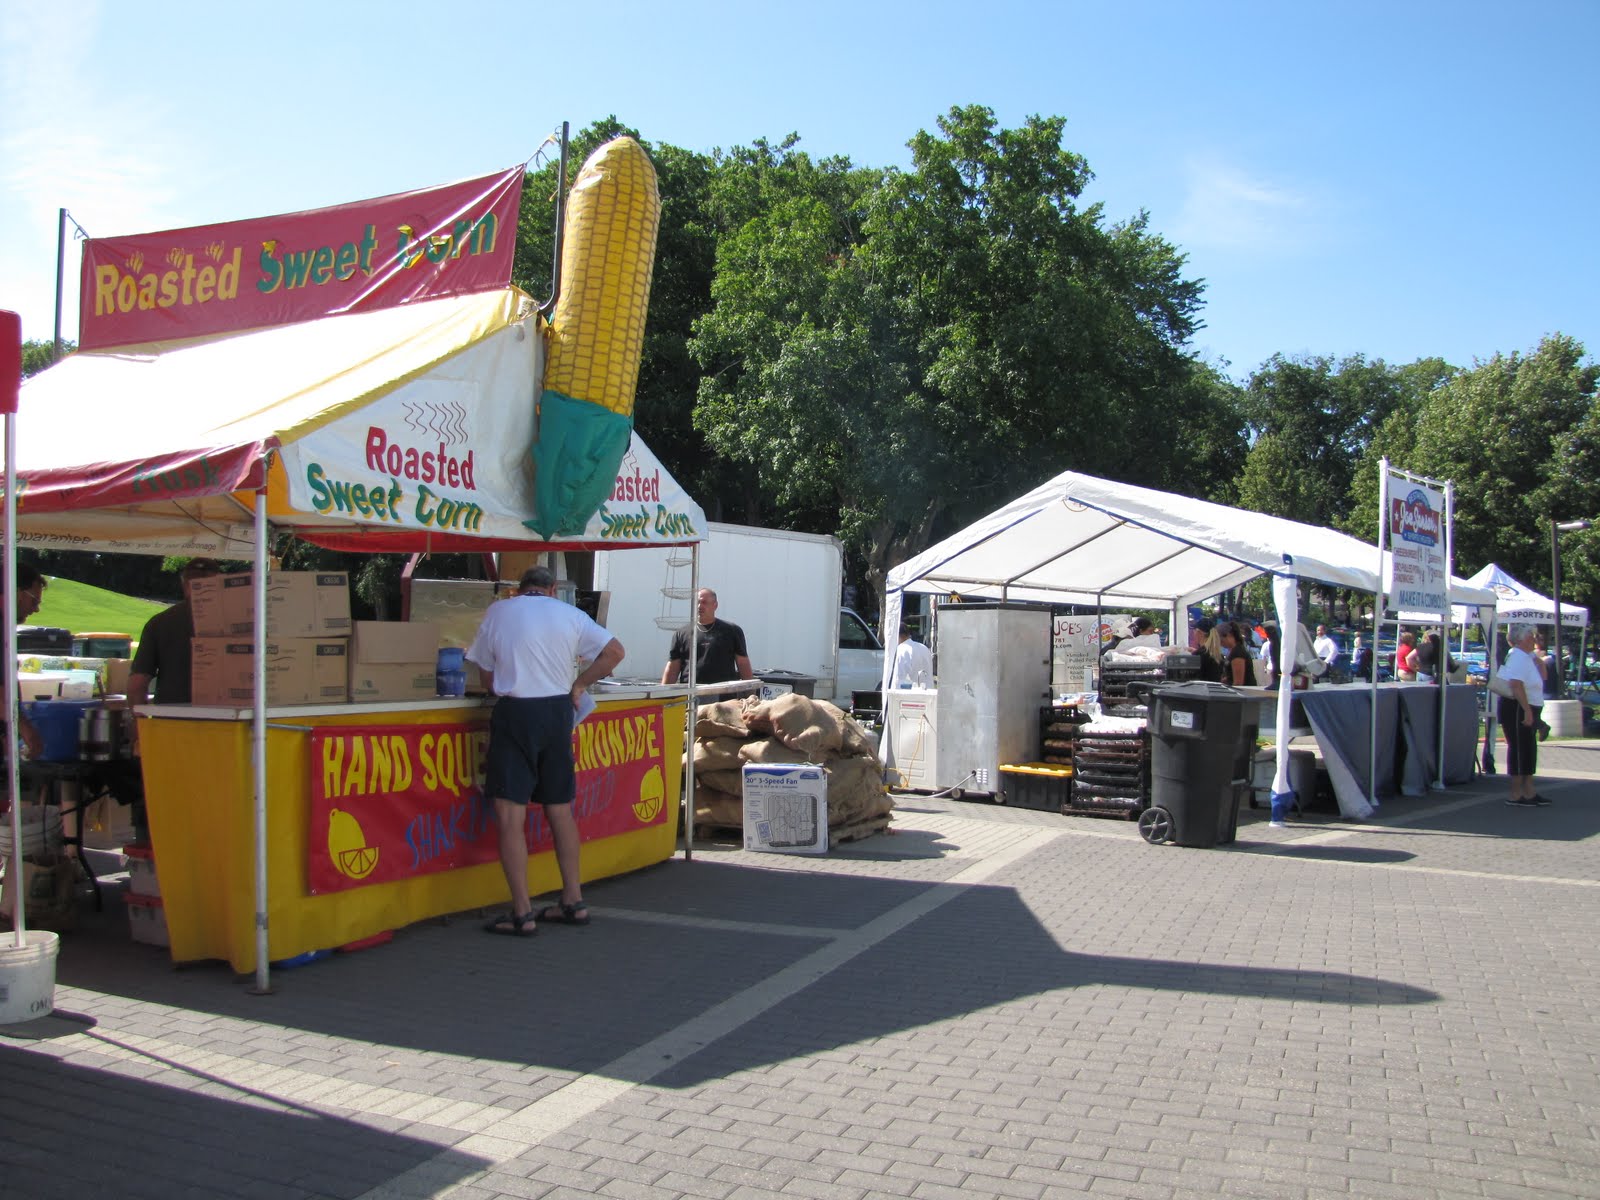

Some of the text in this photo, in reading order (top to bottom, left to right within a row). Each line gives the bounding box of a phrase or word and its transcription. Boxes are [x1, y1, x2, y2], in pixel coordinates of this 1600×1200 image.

[95, 212, 498, 316] Roasted Sweet Corn
[366, 426, 477, 491] Roasted
[307, 462, 485, 533] Sweet Corn
[608, 467, 660, 503] asted
[15, 530, 93, 546] guarantee
[599, 504, 698, 539] Sweet Corn
[1054, 620, 1082, 636] JOE'S
[323, 714, 660, 799] HAND SQUE MONADE
[759, 777, 785, 785] 3-Speed
